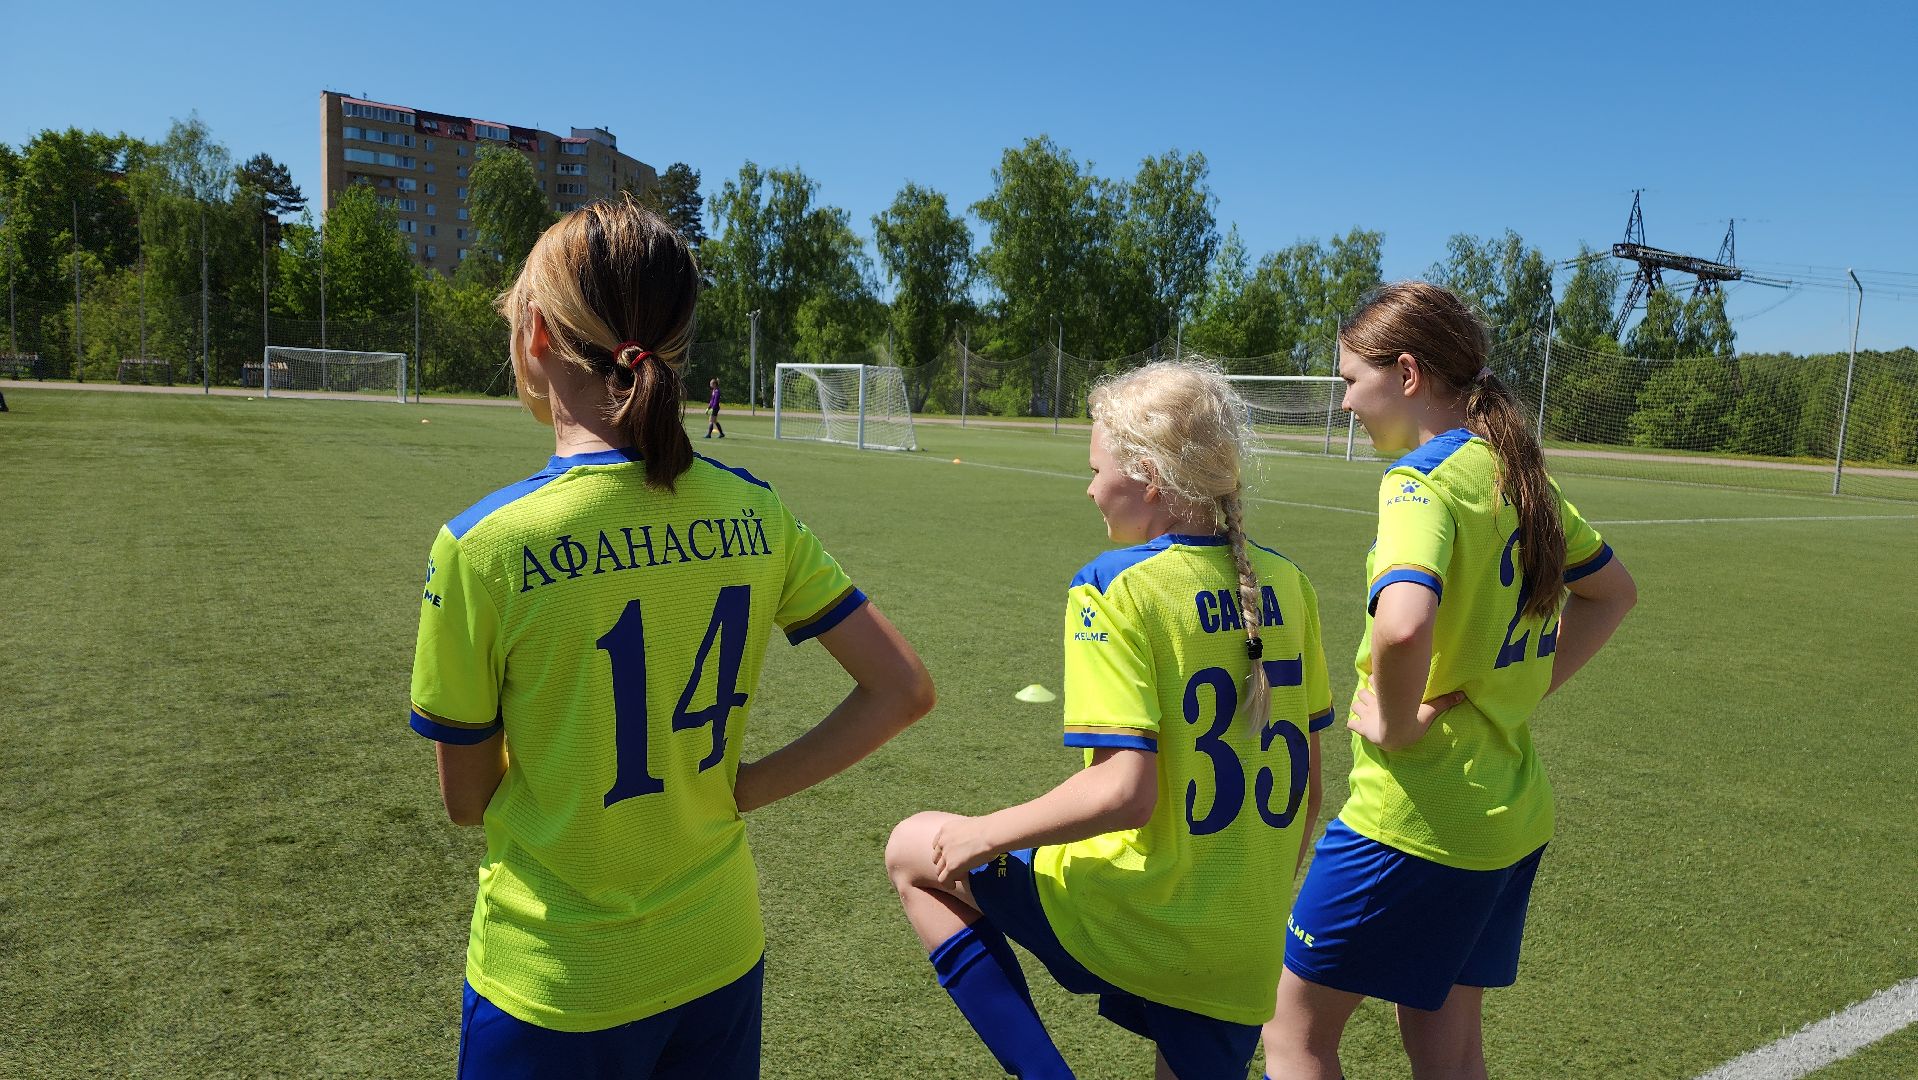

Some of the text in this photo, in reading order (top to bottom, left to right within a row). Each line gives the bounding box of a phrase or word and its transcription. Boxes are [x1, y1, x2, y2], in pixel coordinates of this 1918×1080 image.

[1386, 495, 1431, 506] KELME
[520, 508, 773, 593] АФАНАСИЙ
[1074, 632, 1109, 642] KELME
[1195, 585, 1284, 634] САА
[595, 584, 751, 809] 14
[1183, 653, 1310, 836] 35
